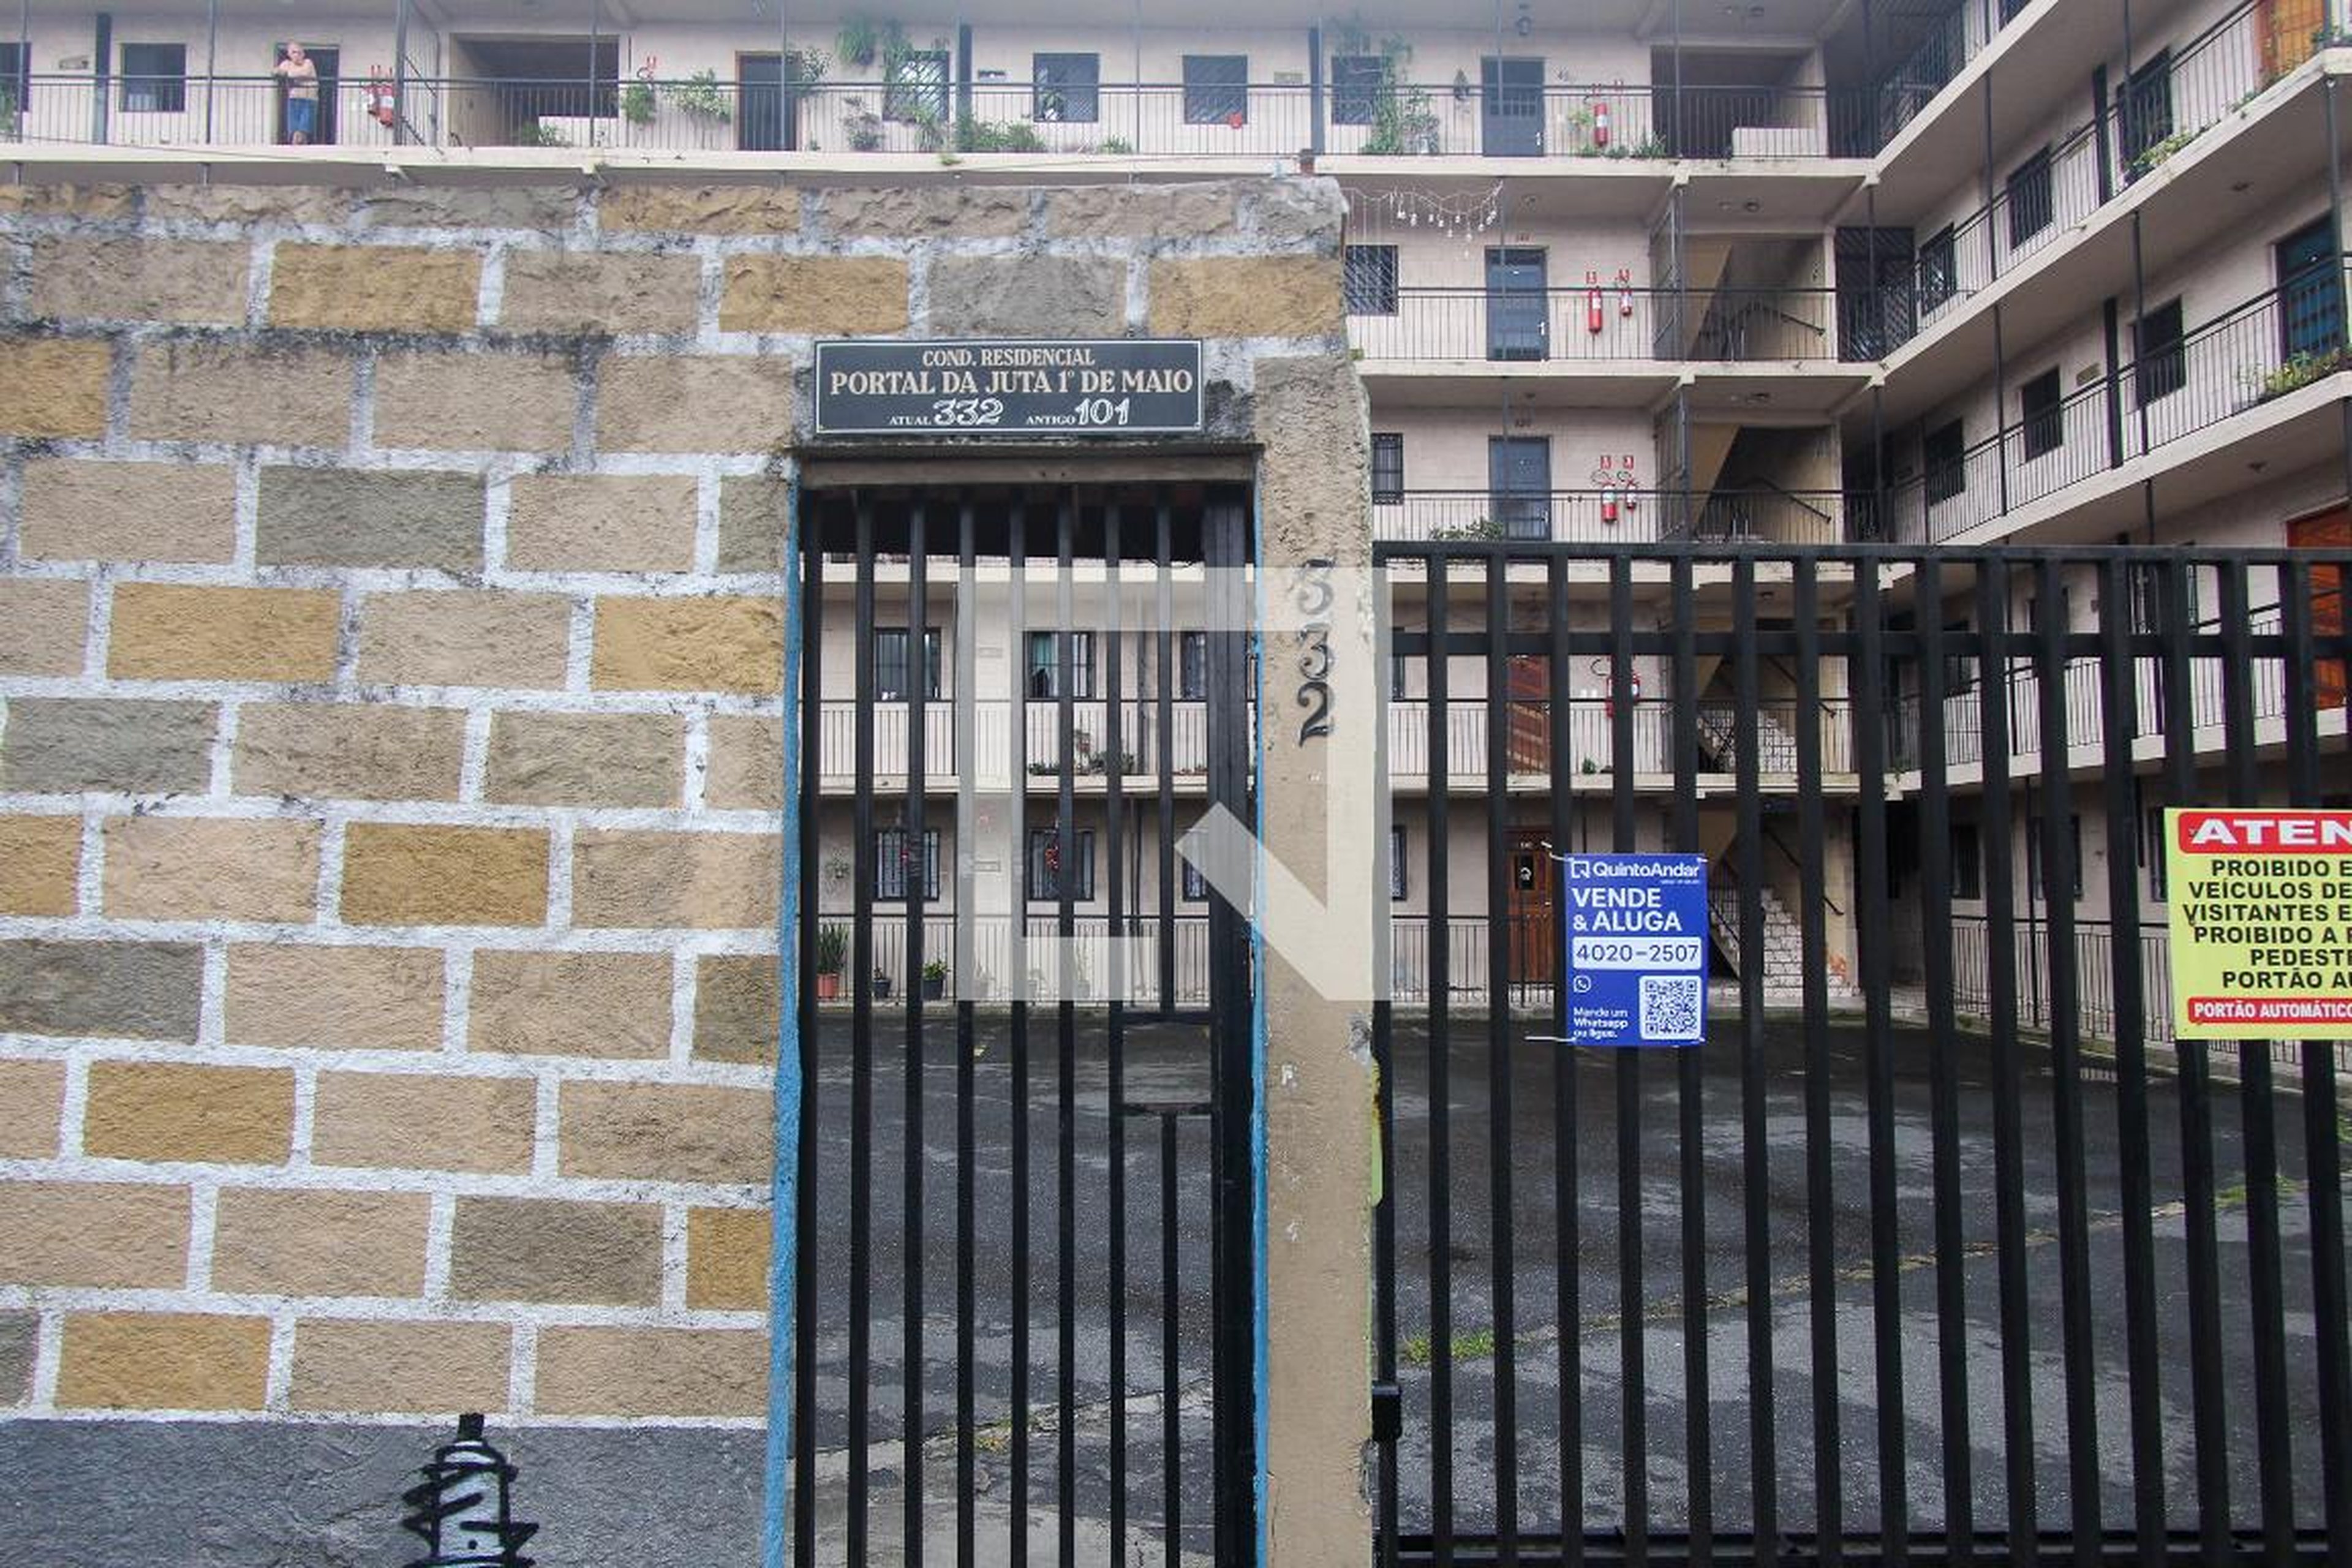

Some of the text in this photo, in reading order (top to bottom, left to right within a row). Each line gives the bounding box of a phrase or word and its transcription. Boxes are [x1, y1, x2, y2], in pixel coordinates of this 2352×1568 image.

[922, 348, 1095, 368] COND. RESIDENCIAL
[830, 371, 935, 395] PORTAL
[942, 371, 974, 394] DA
[984, 371, 1048, 394] JUTA
[1080, 369, 1115, 393] DE
[1121, 369, 1193, 393] MAIO
[889, 398, 1130, 426] ATUAL 332 ANTIGO 101
[1297, 558, 1335, 748] 332
[1593, 862, 1700, 877] QuintoAndar
[2211, 859, 2331, 877] PROIBIDO
[1572, 888, 1662, 908] VENDE
[2188, 878, 2352, 899] VEÍCULOS DE
[1573, 910, 1683, 932] & ALUGA
[2182, 903, 2352, 921] VISITANTES E
[2194, 927, 2313, 944] PROIBIDO
[2321, 927, 2338, 944] A
[1576, 944, 1700, 962] 4020-2507
[2223, 967, 2323, 989] PORTÃO
[2194, 1000, 2255, 1018] PORTÃO
